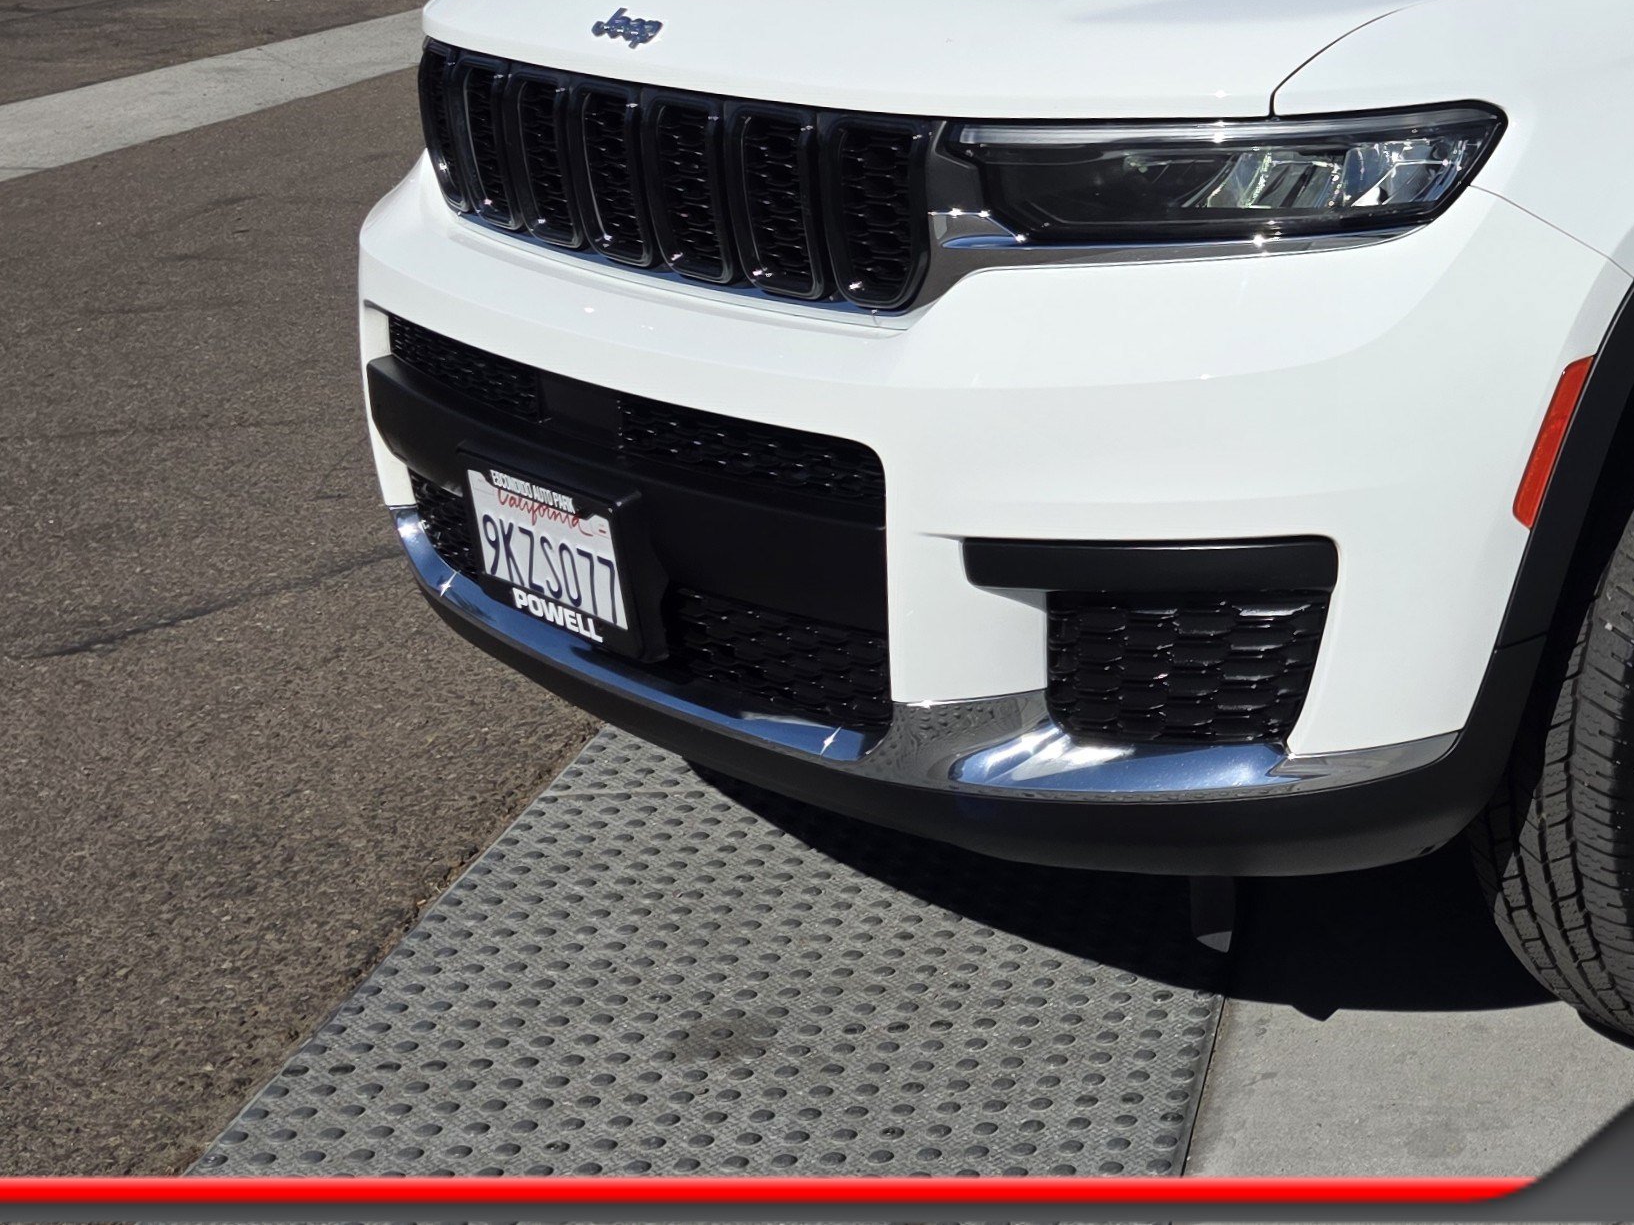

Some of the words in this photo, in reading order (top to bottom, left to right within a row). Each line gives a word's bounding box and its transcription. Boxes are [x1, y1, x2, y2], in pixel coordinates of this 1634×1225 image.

[591, 7, 663, 49] Jeep
[533, 485, 554, 506] AUTO
[554, 491, 576, 514] PARK
[482, 514, 617, 624] 9KZS077
[512, 587, 603, 643] POWELL
